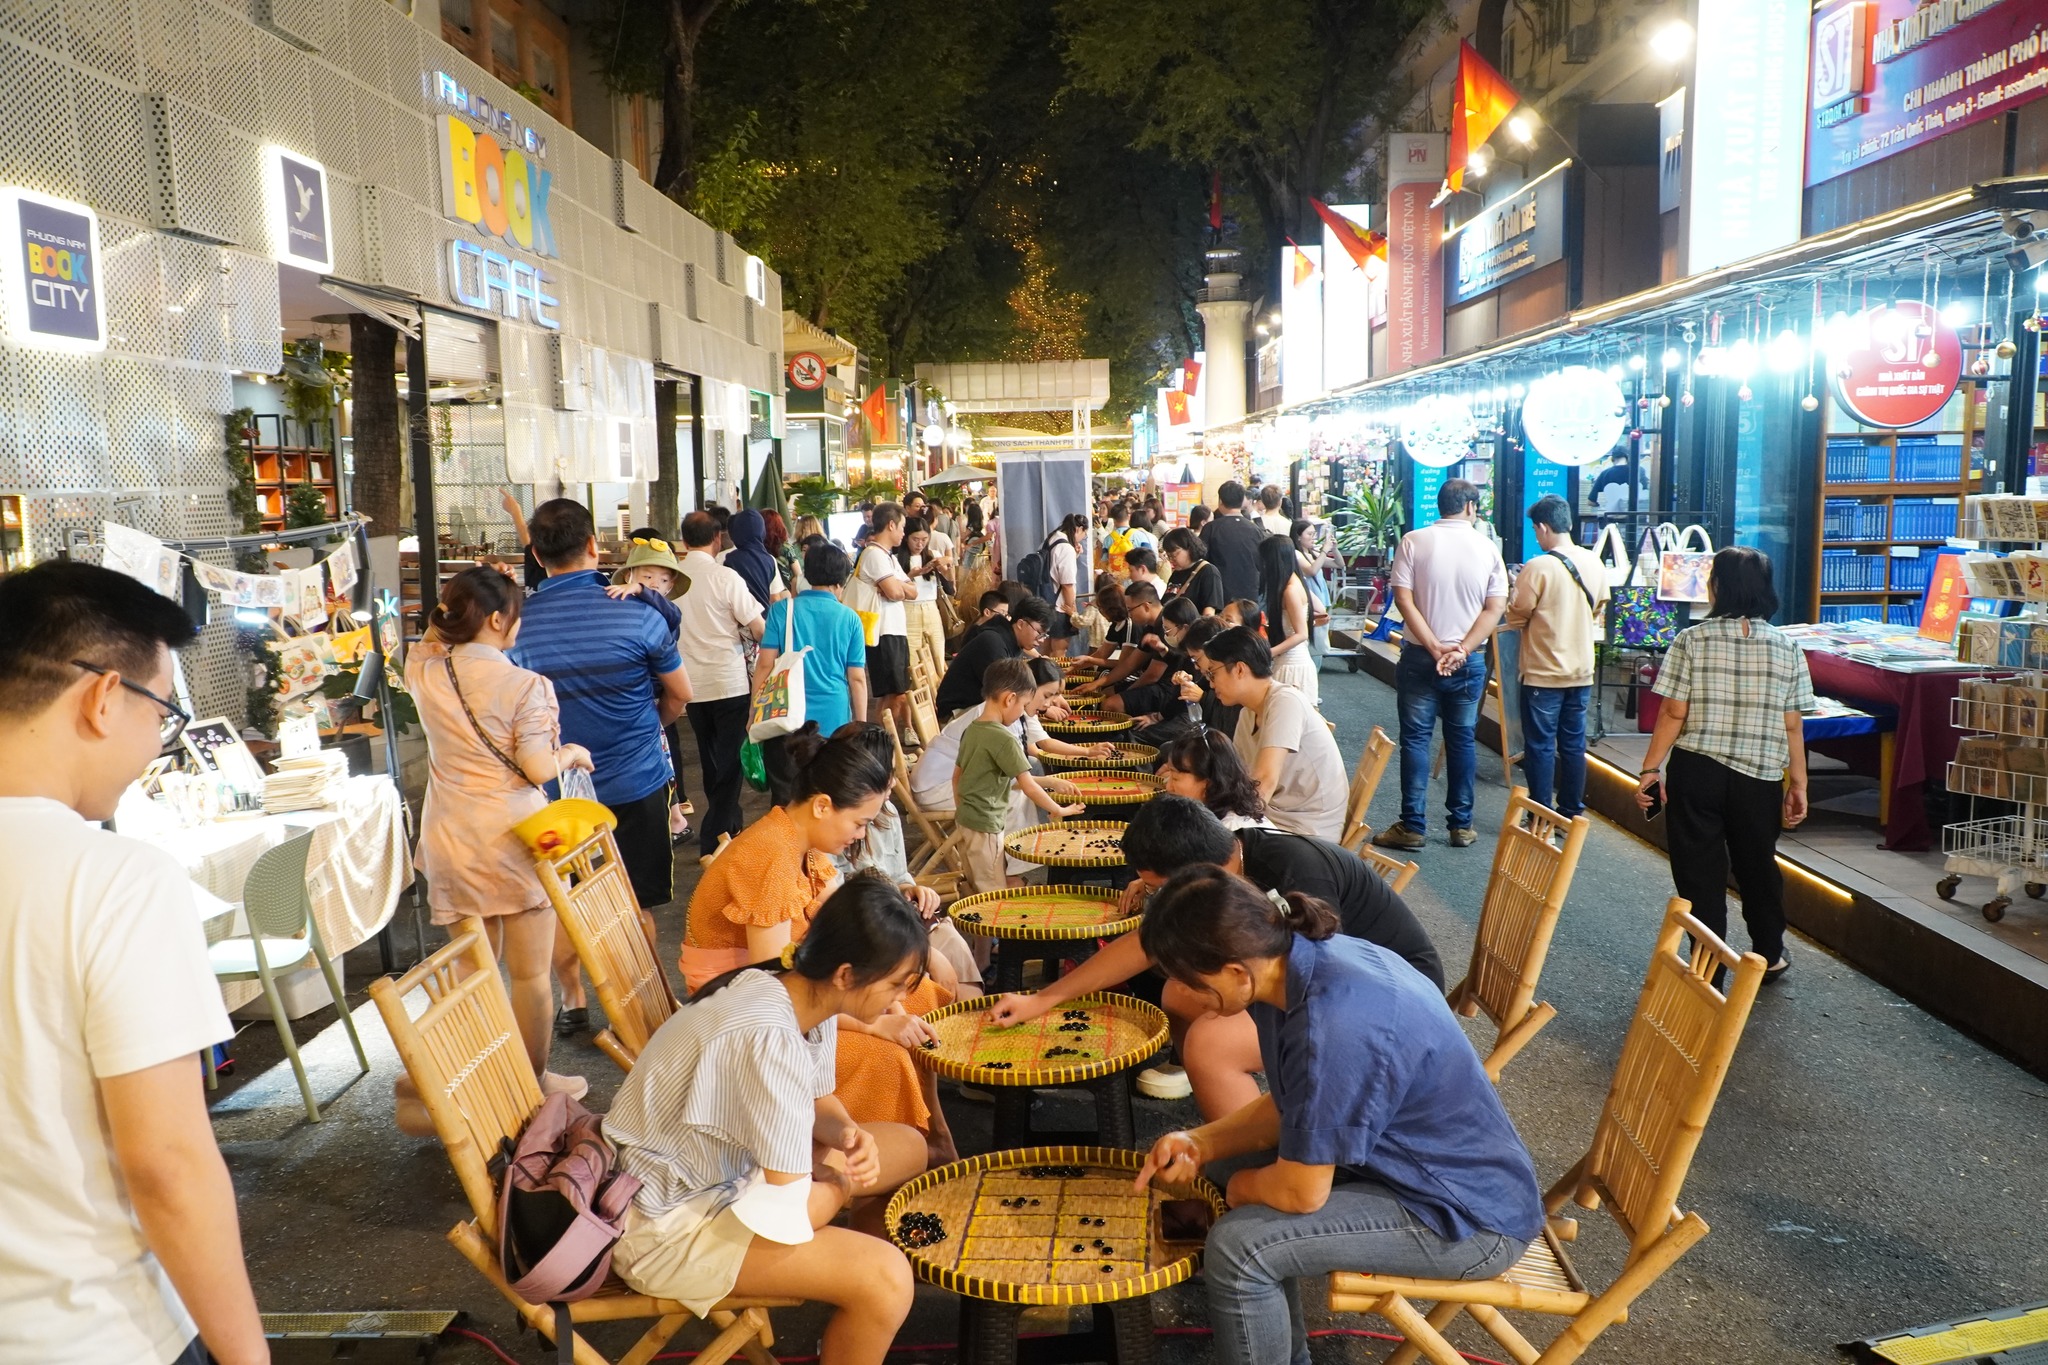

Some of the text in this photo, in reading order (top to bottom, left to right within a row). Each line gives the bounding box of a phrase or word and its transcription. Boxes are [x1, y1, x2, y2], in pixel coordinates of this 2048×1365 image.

[1903, 88, 1923, 113] CHI
[1923, 71, 1963, 104] NHÁNH
[1965, 53, 2008, 86] THÀNH
[2008, 23, 2041, 67] PHỐ
[1880, 131, 1890, 149] 72
[1890, 124, 1906, 145] Trần
[1966, 96, 1973, 116] 3
[440, 114, 559, 259] BOOK
[26, 229, 87, 250] PHUONG NAM
[1421, 232, 1433, 276] Publishing
[28, 242, 88, 284] BOOK
[447, 239, 560, 330] CAFE
[1398, 192, 1416, 364] NHÀ XUẤT BẢN PHỤ NỮ VIỆT NAM
[31, 279, 89, 312] CITY
[1420, 278, 1430, 314] Women's
[1420, 315, 1430, 350] Vietnam
